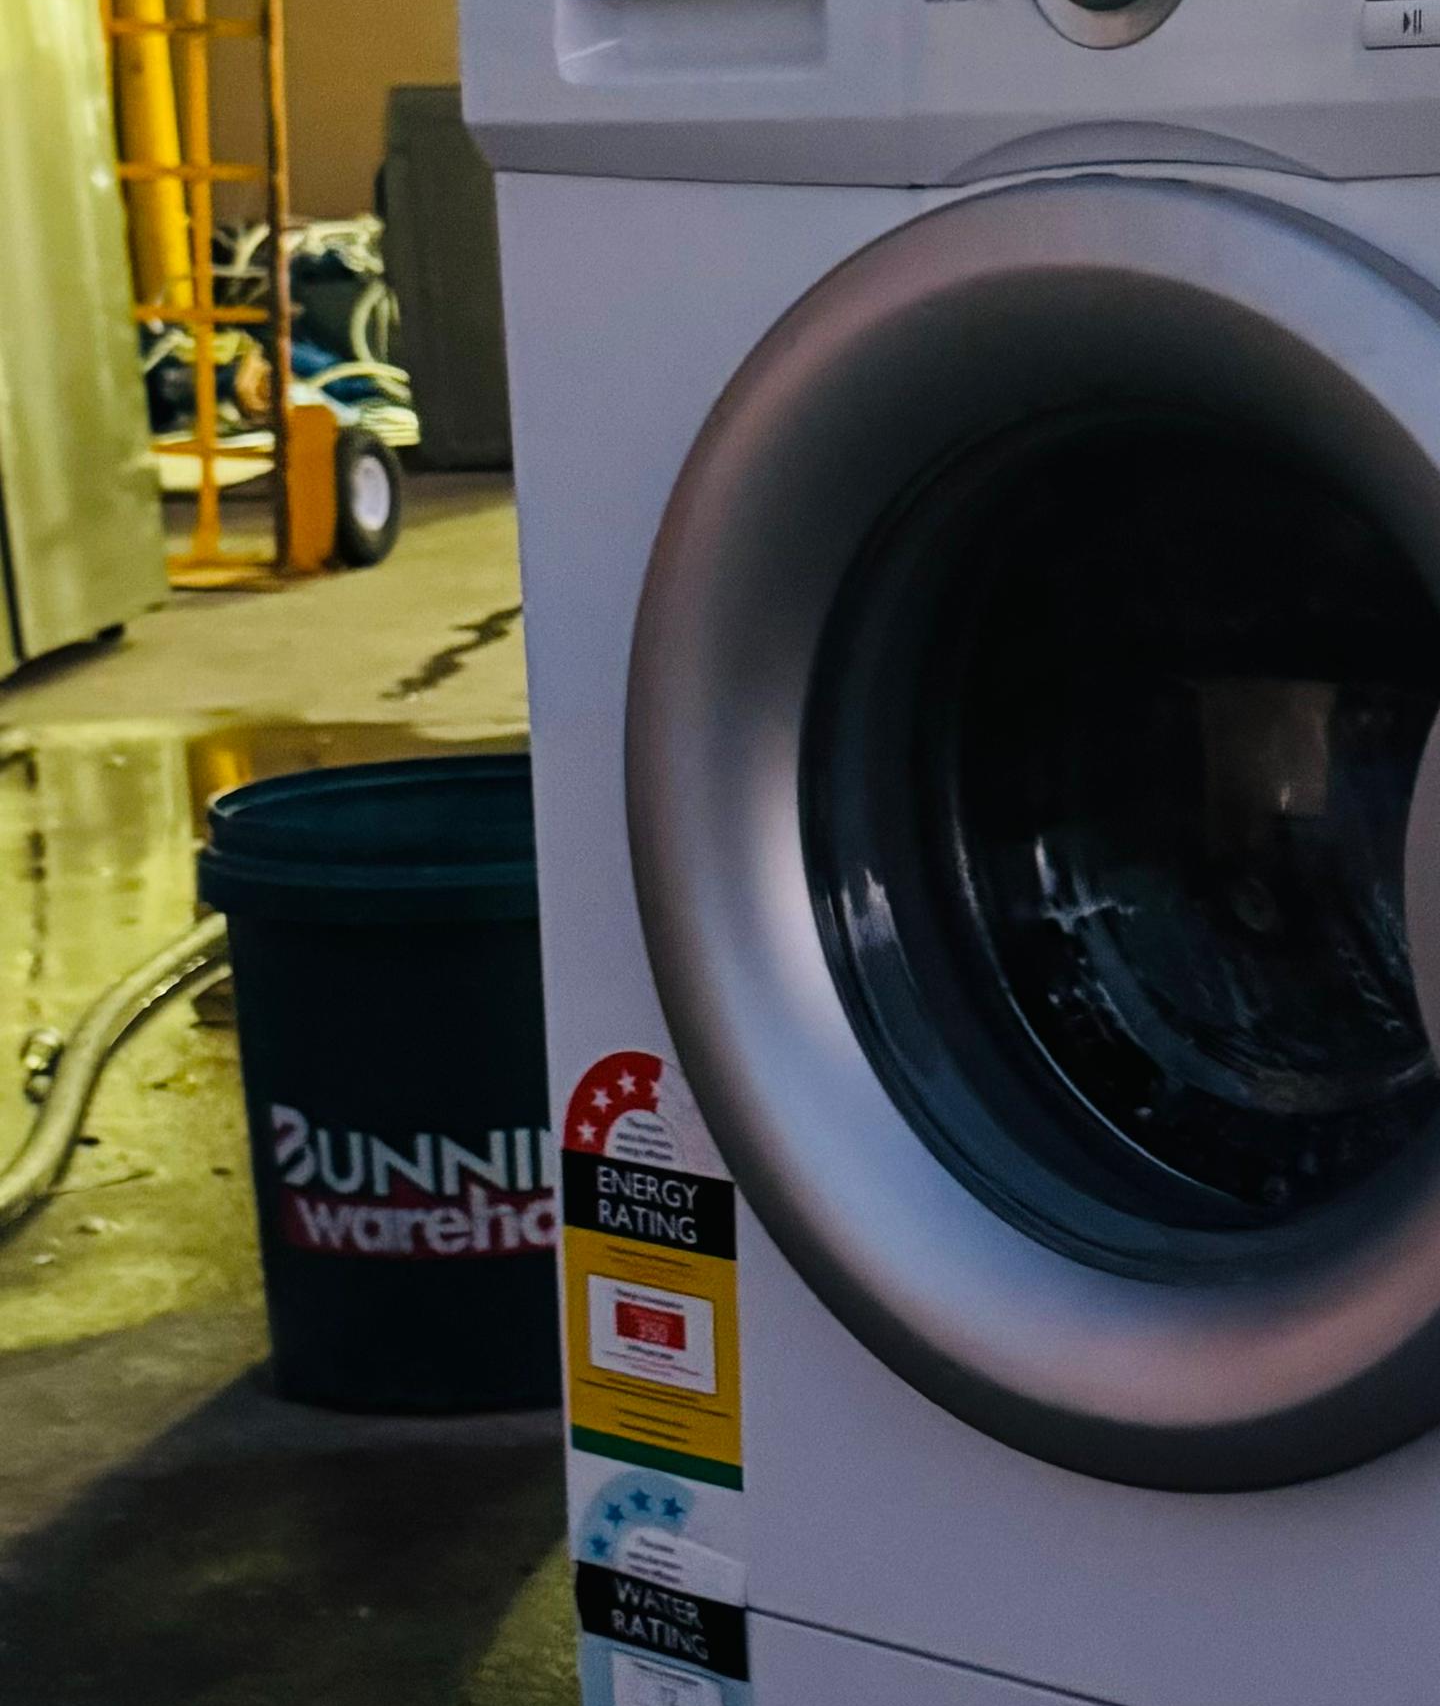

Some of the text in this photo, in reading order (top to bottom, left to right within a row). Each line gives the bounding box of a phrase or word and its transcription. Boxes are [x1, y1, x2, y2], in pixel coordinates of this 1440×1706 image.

[596, 1164, 699, 1211] ENERGY
[597, 1198, 699, 1245] RATING
[613, 1577, 704, 1630] WATER
[610, 1608, 711, 1662] RATING
